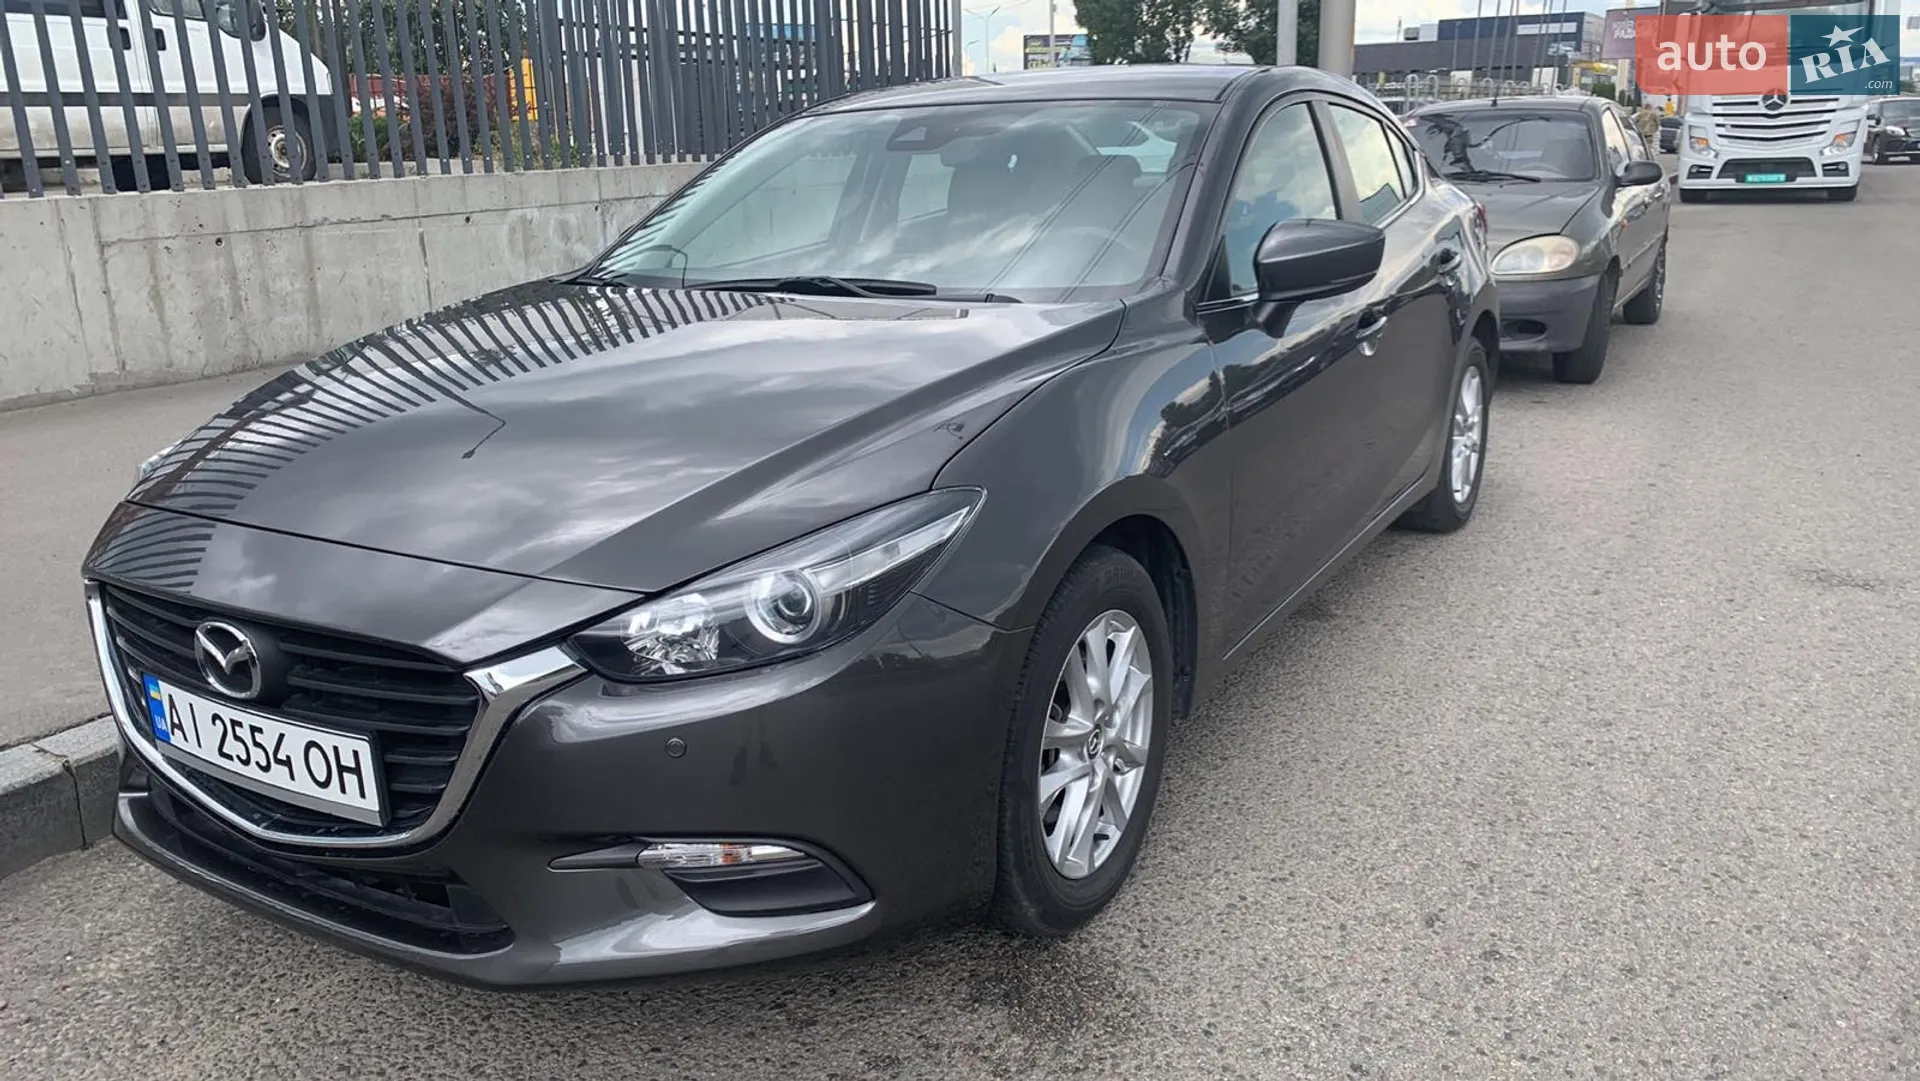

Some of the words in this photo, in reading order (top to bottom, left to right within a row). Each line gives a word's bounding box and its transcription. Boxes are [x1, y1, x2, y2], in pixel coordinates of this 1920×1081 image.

[154, 714, 168, 732] UA
[168, 693, 202, 748] AI
[211, 712, 296, 781] 2554
[303, 740, 366, 799] OH
